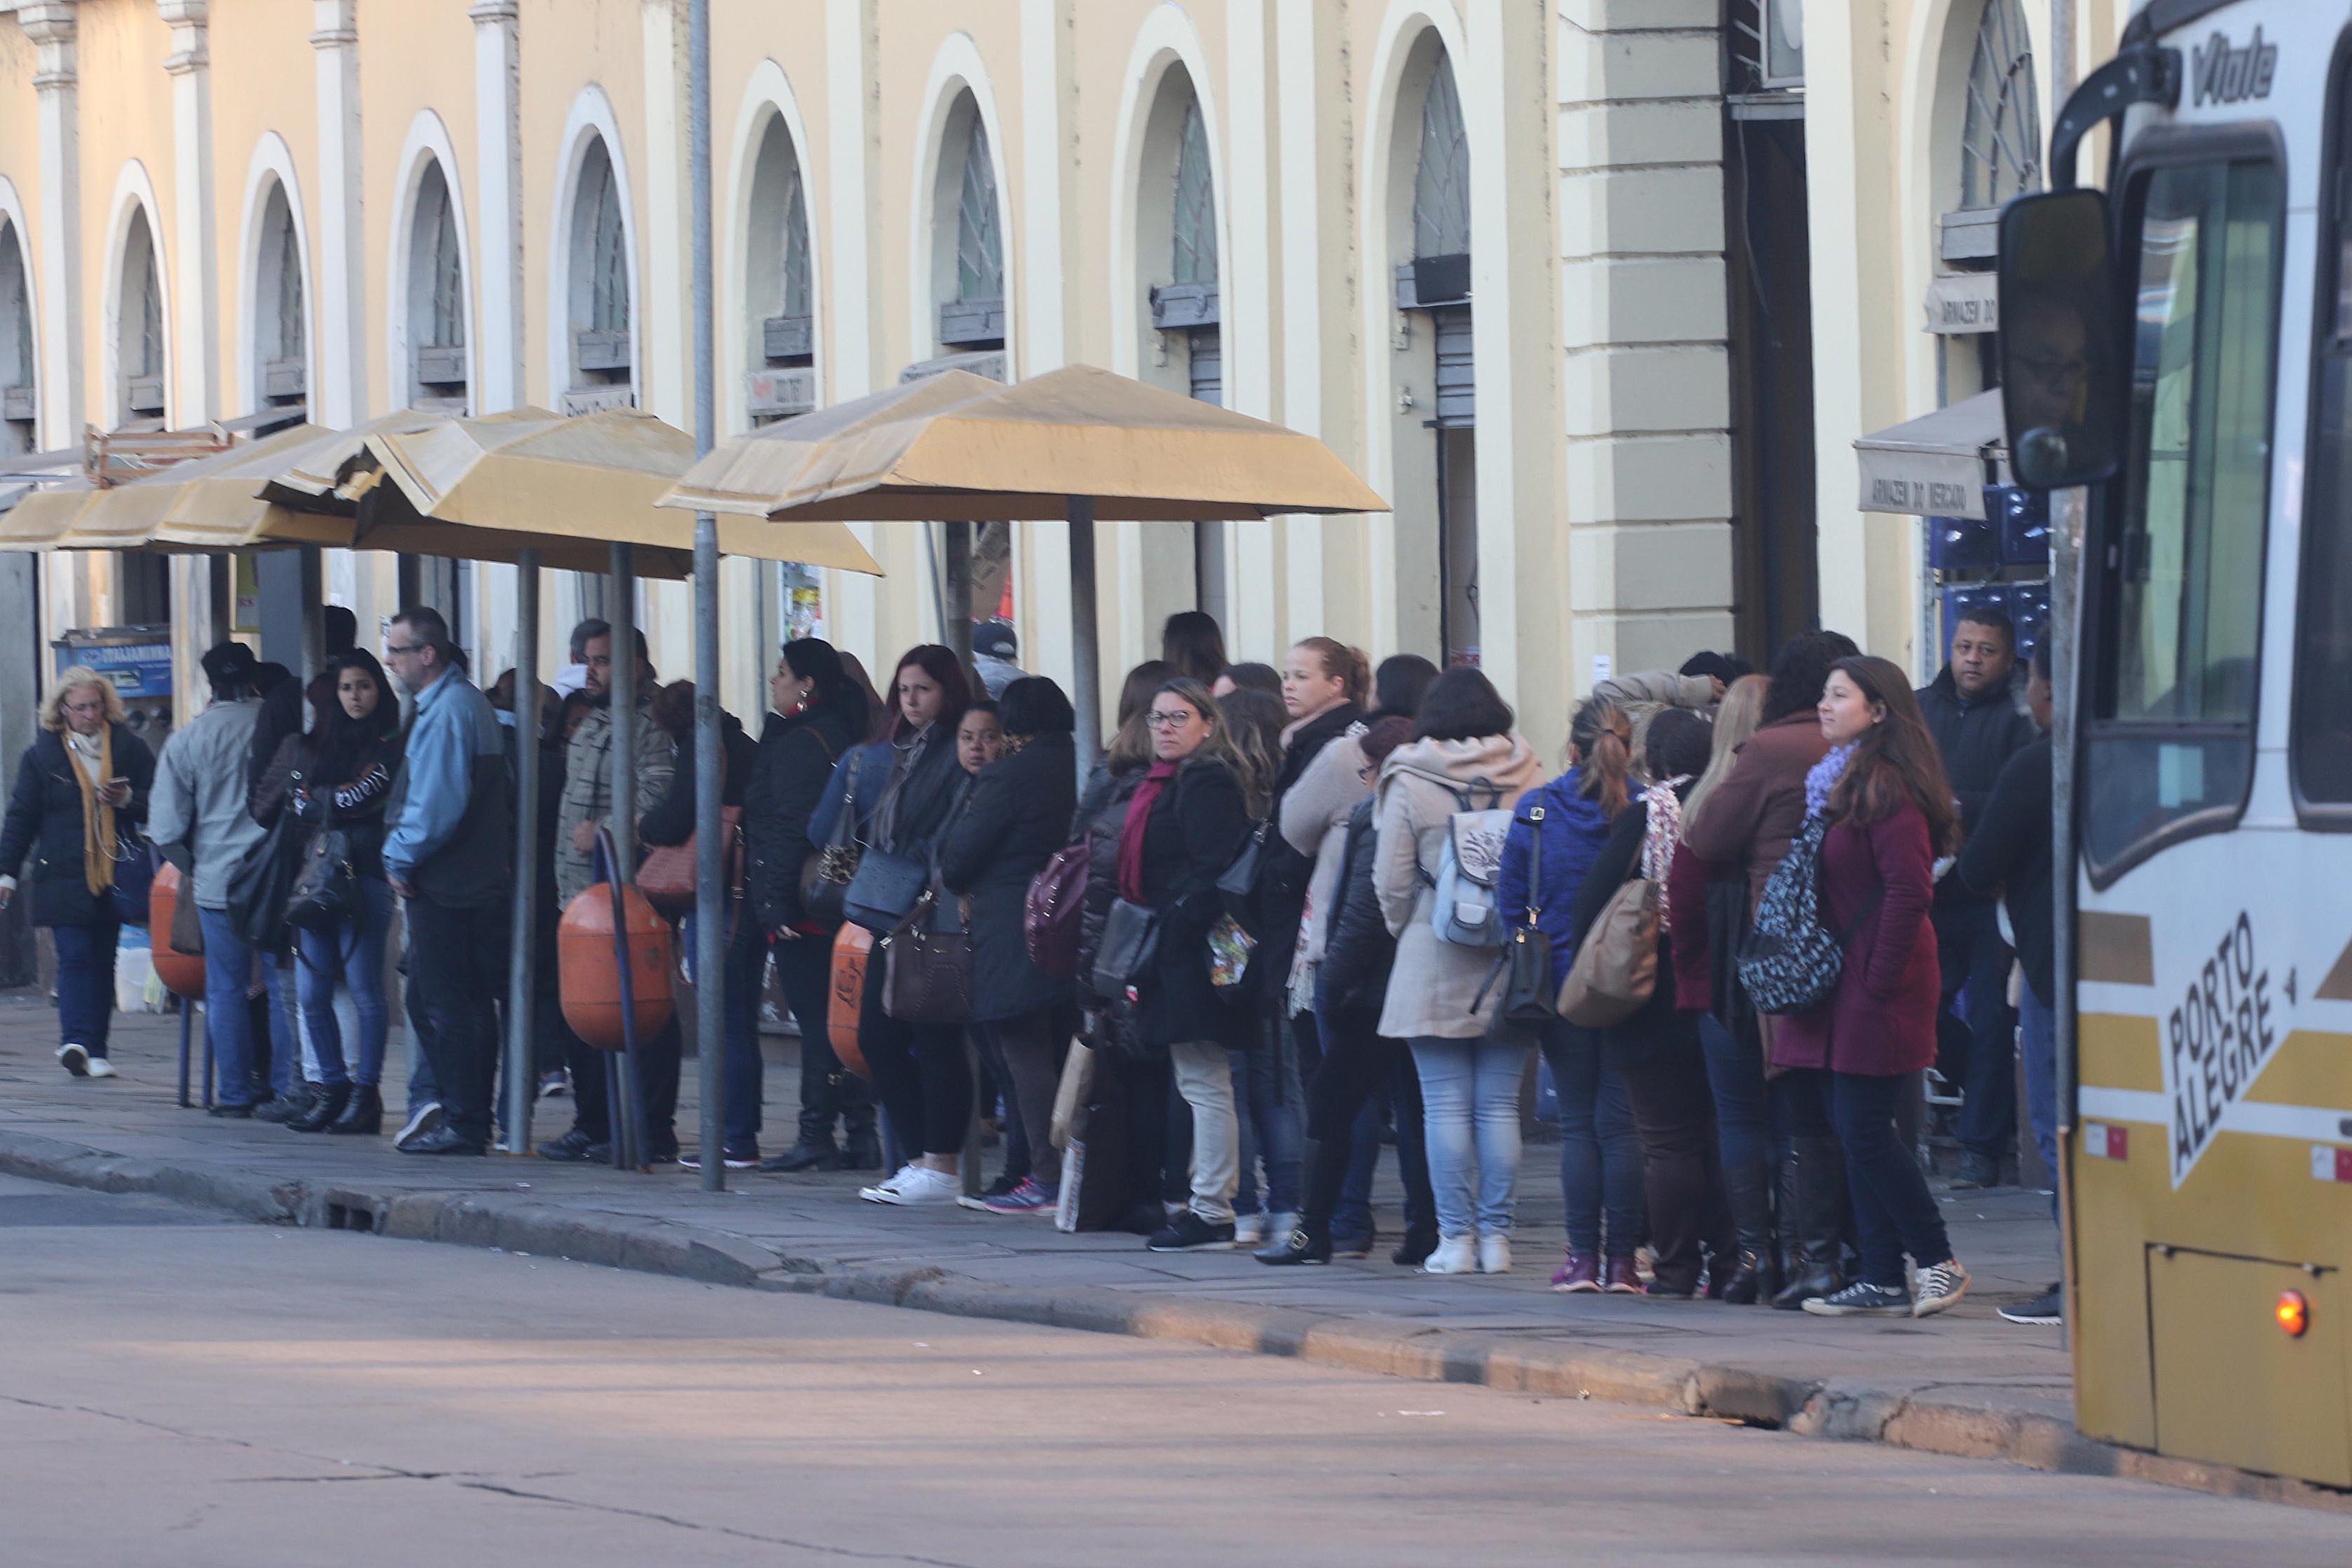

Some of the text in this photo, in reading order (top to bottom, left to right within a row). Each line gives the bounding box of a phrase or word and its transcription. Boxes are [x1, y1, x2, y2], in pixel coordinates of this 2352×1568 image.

[2192, 23, 2278, 107] Viale
[1929, 482, 1967, 510] MERCADO
[2170, 909, 2253, 1088] PORTO
[2176, 968, 2273, 1177] ALEGRE
